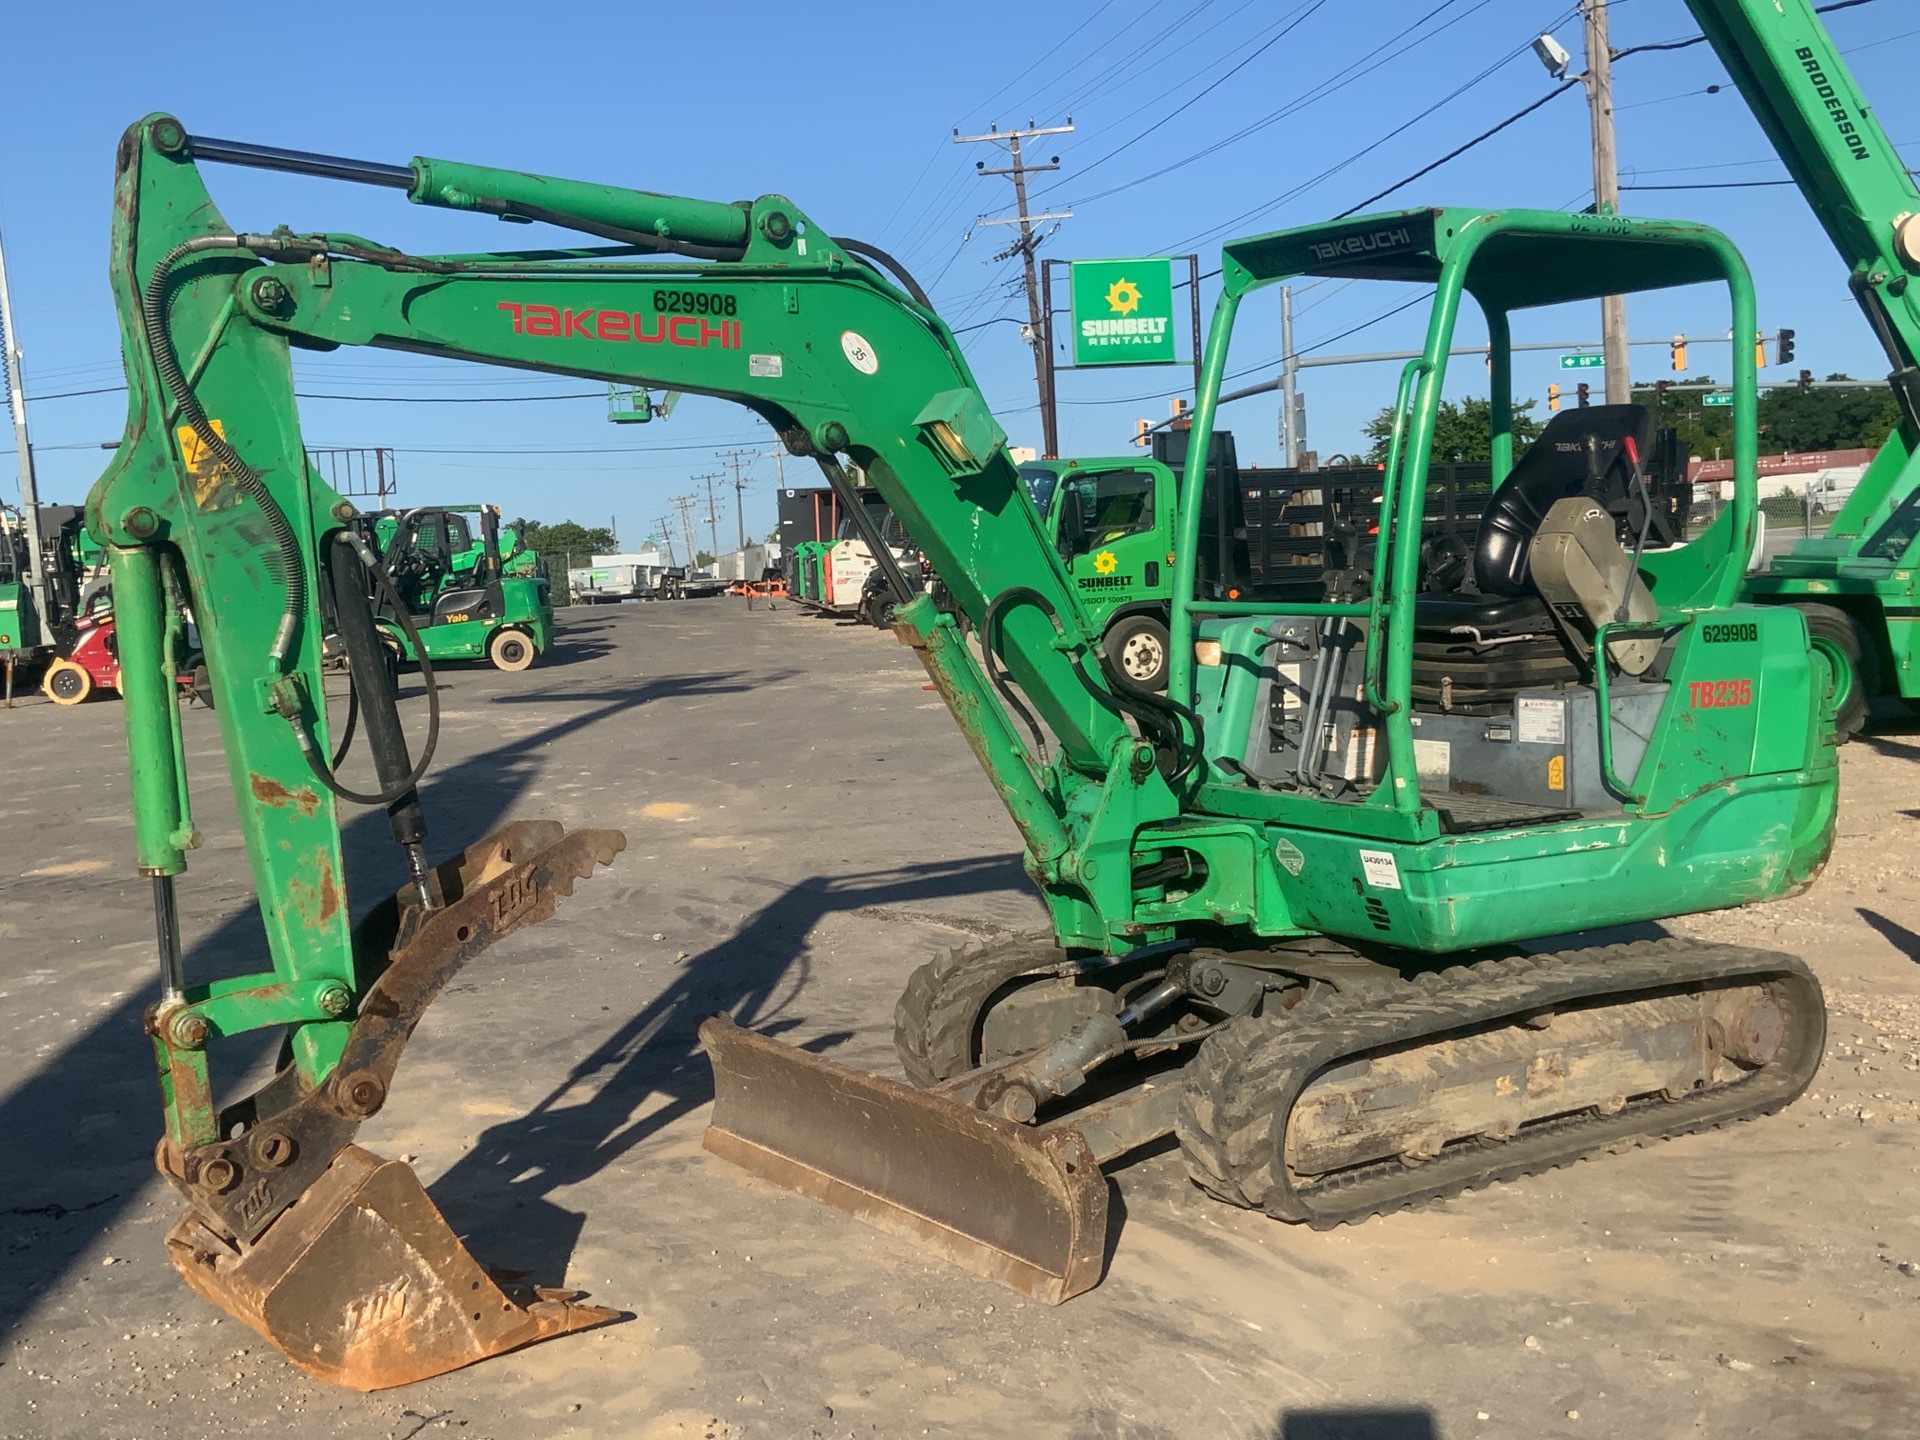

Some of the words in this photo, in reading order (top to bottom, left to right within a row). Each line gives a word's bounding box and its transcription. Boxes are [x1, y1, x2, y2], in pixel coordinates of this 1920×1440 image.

[1794, 46, 1871, 161] BRODERSON
[1308, 228, 1411, 260] TAKEUCHI
[653, 289, 737, 316] 629908
[497, 302, 741, 350] TAKEUCHI
[1081, 317, 1168, 337] SUNBELT
[1088, 335, 1163, 346] RENTALS
[851, 346, 868, 361] 35
[1554, 440, 1617, 452] TAKHI
[1077, 575, 1133, 589] SUNBELT
[1080, 596, 1106, 605] USDOT
[445, 613, 469, 624] Yale
[1702, 623, 1758, 643] 629908
[1688, 679, 1753, 709] TB235
[1363, 855, 1393, 866] U430134
